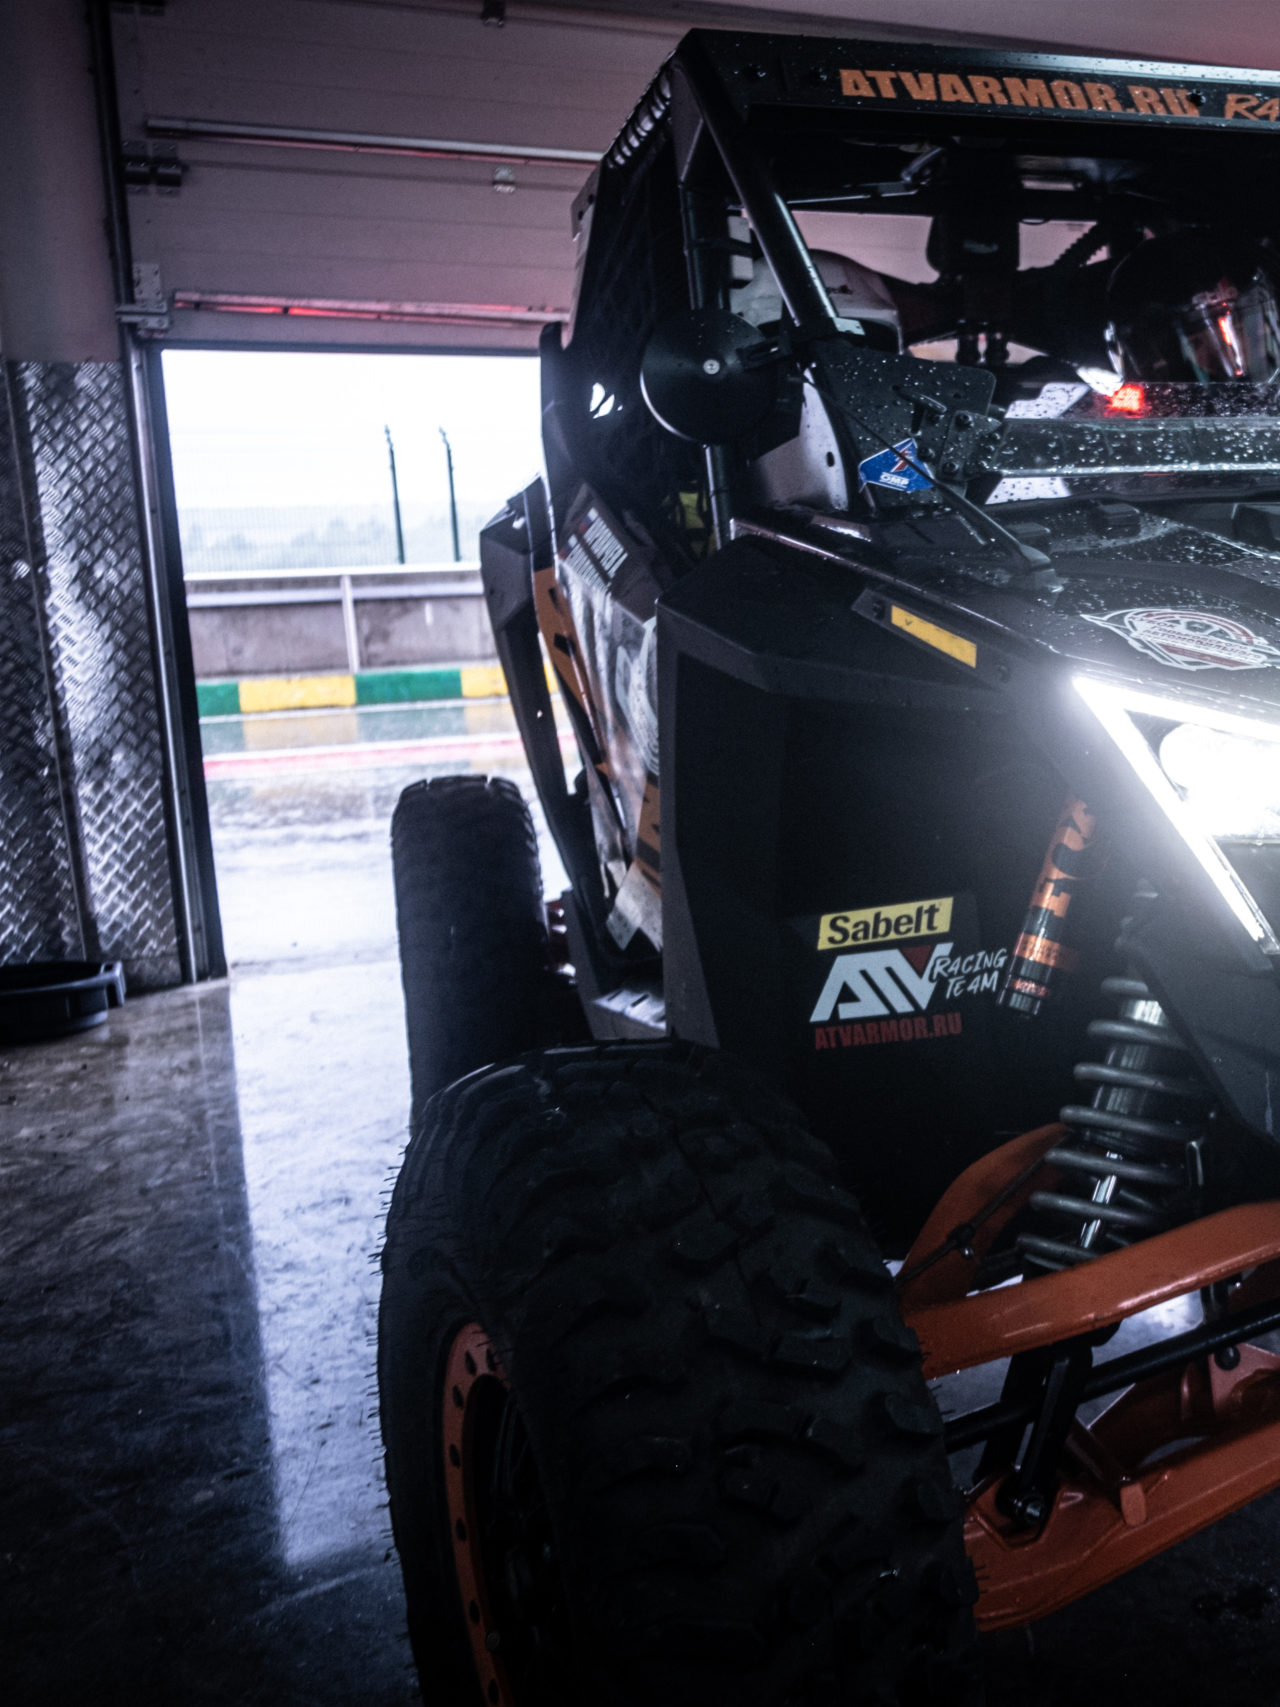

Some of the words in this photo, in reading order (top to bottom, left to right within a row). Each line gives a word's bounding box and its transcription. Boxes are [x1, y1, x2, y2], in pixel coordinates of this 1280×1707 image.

[839, 69, 1200, 117] ATVARMOR.RU
[827, 905, 940, 945] Sabelt
[809, 942, 954, 1023] ATV
[933, 948, 1008, 978] RACING
[943, 971, 999, 999] TEAM
[815, 1012, 963, 1050] ATVARMOR.RU
